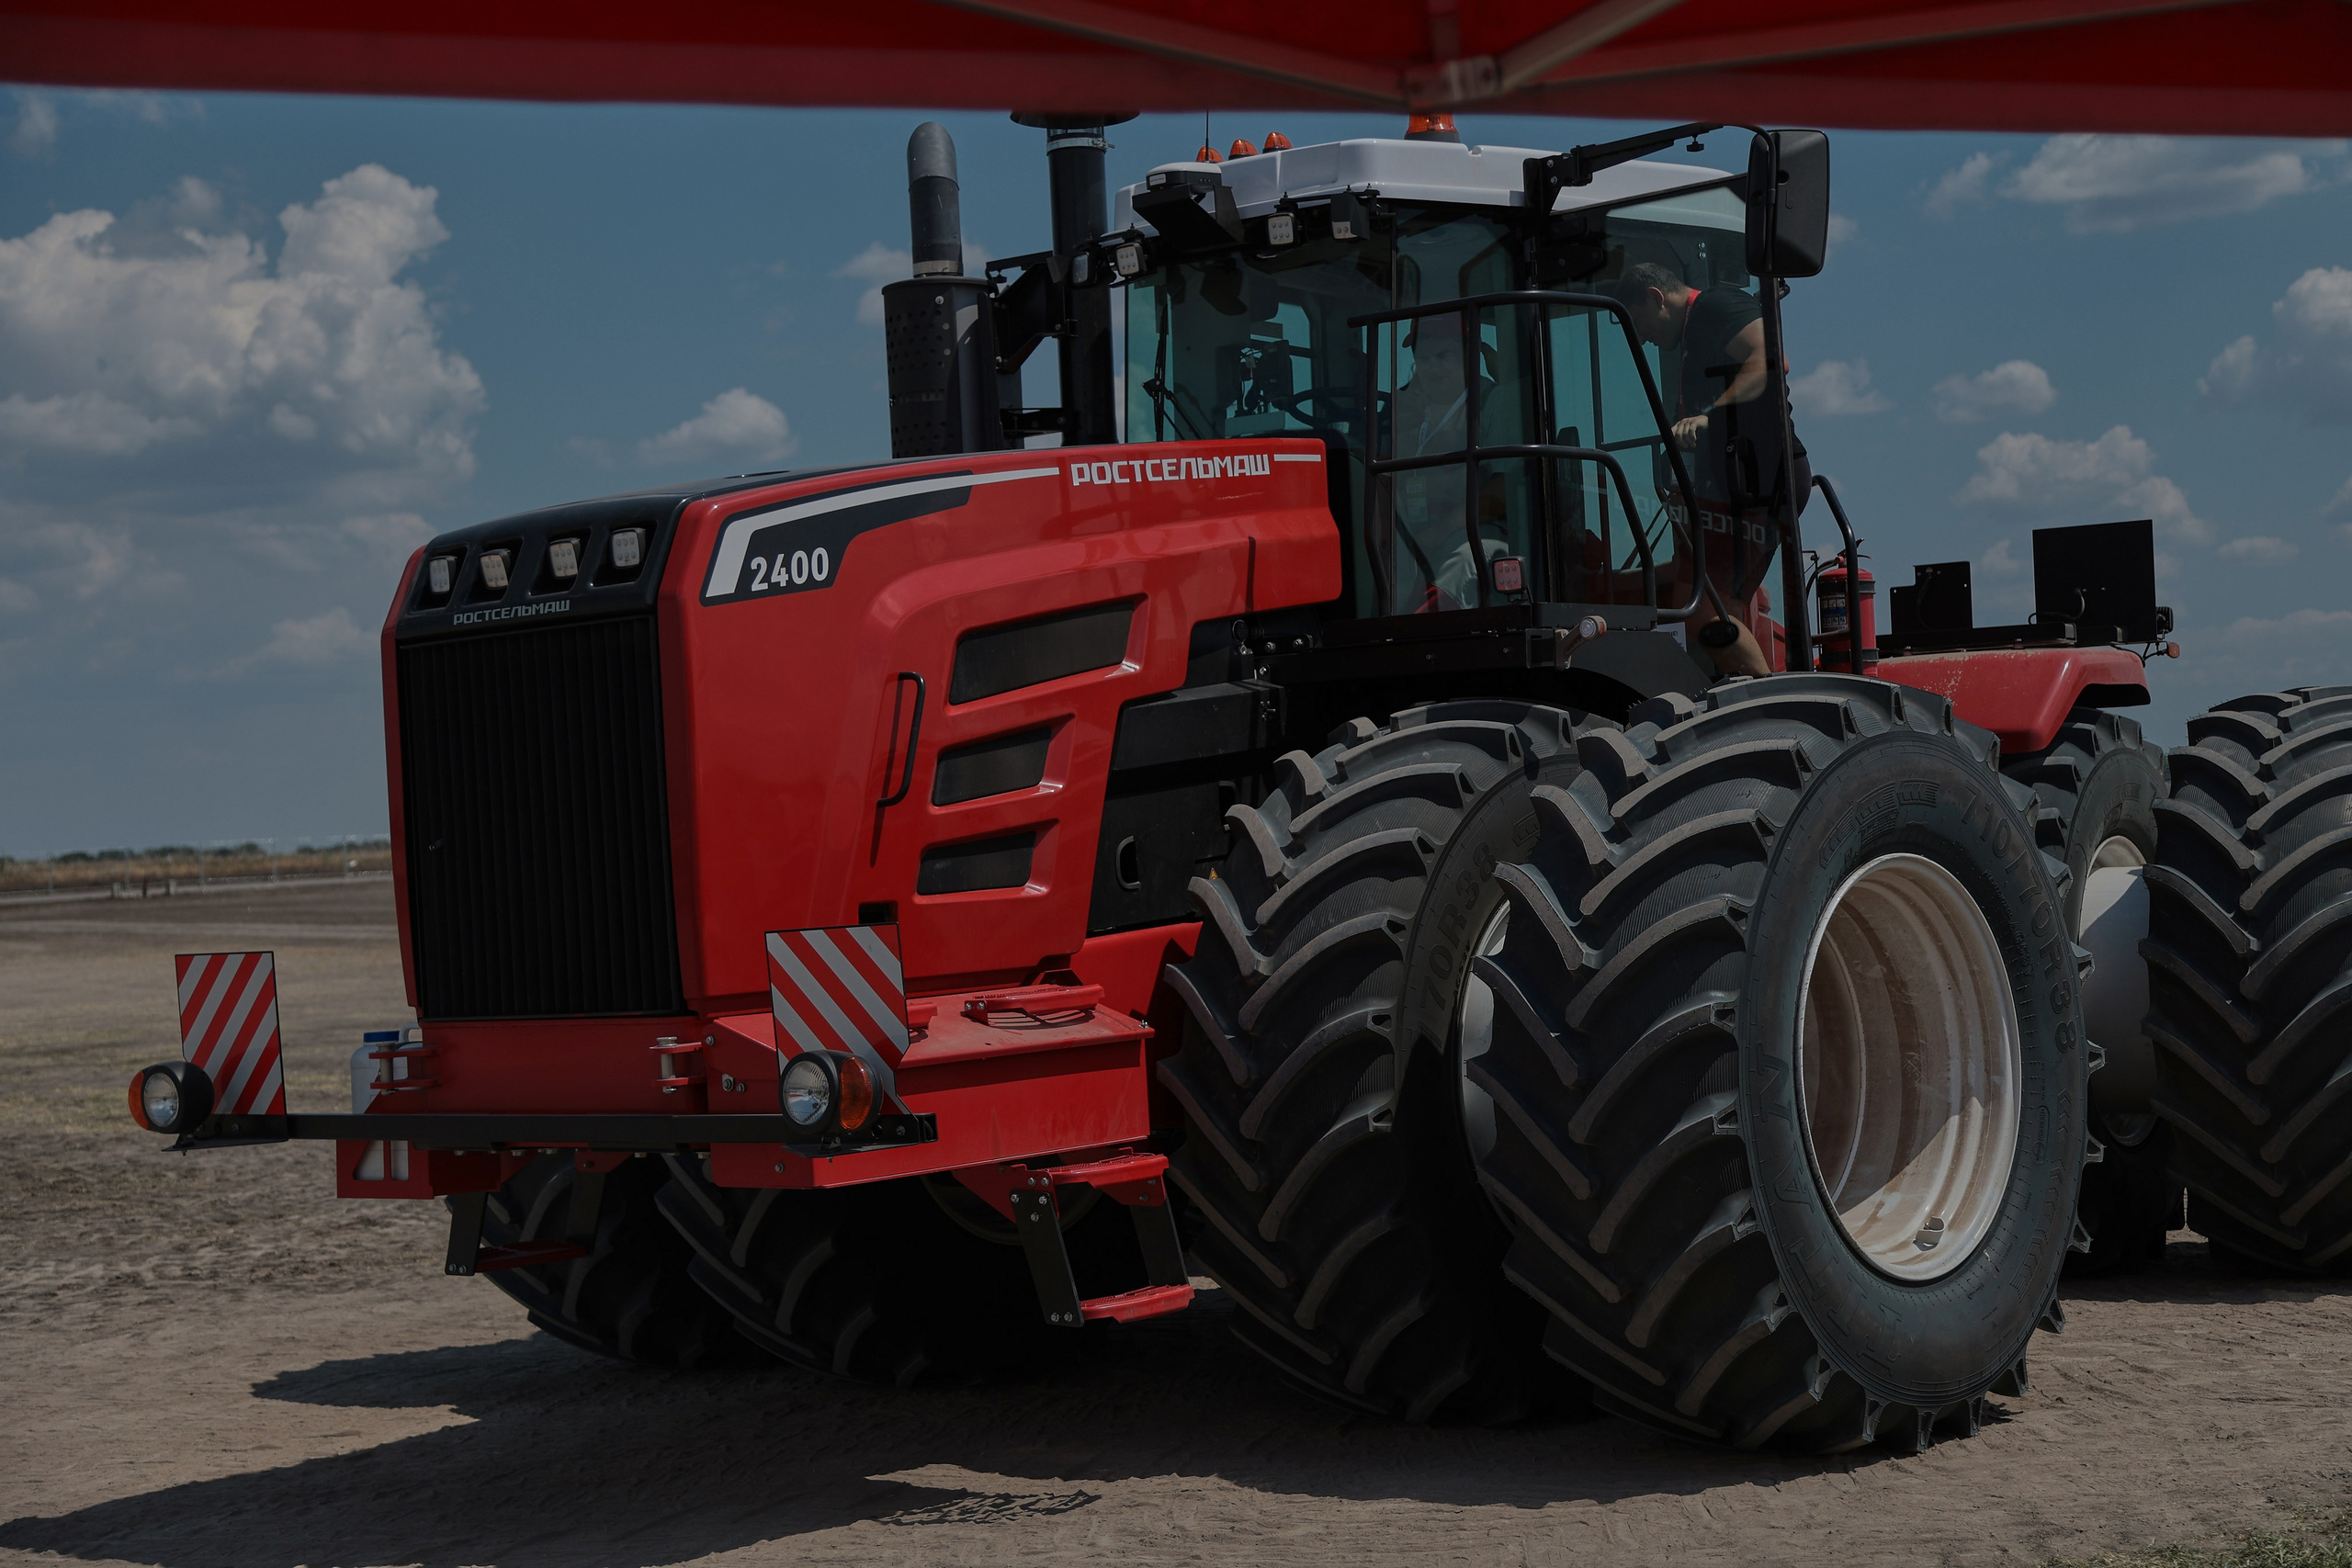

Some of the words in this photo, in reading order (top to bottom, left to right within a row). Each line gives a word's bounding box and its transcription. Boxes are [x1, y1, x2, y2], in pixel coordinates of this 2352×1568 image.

[1070, 454, 1271, 486] РОСТСЕЛЬМАШ
[750, 547, 830, 592] 2400
[453, 599, 571, 626] РОСТСЕЛЬМАШ
[1962, 784, 2078, 1054] 710/70R38
[1756, 1040, 1903, 1378] TITAN
